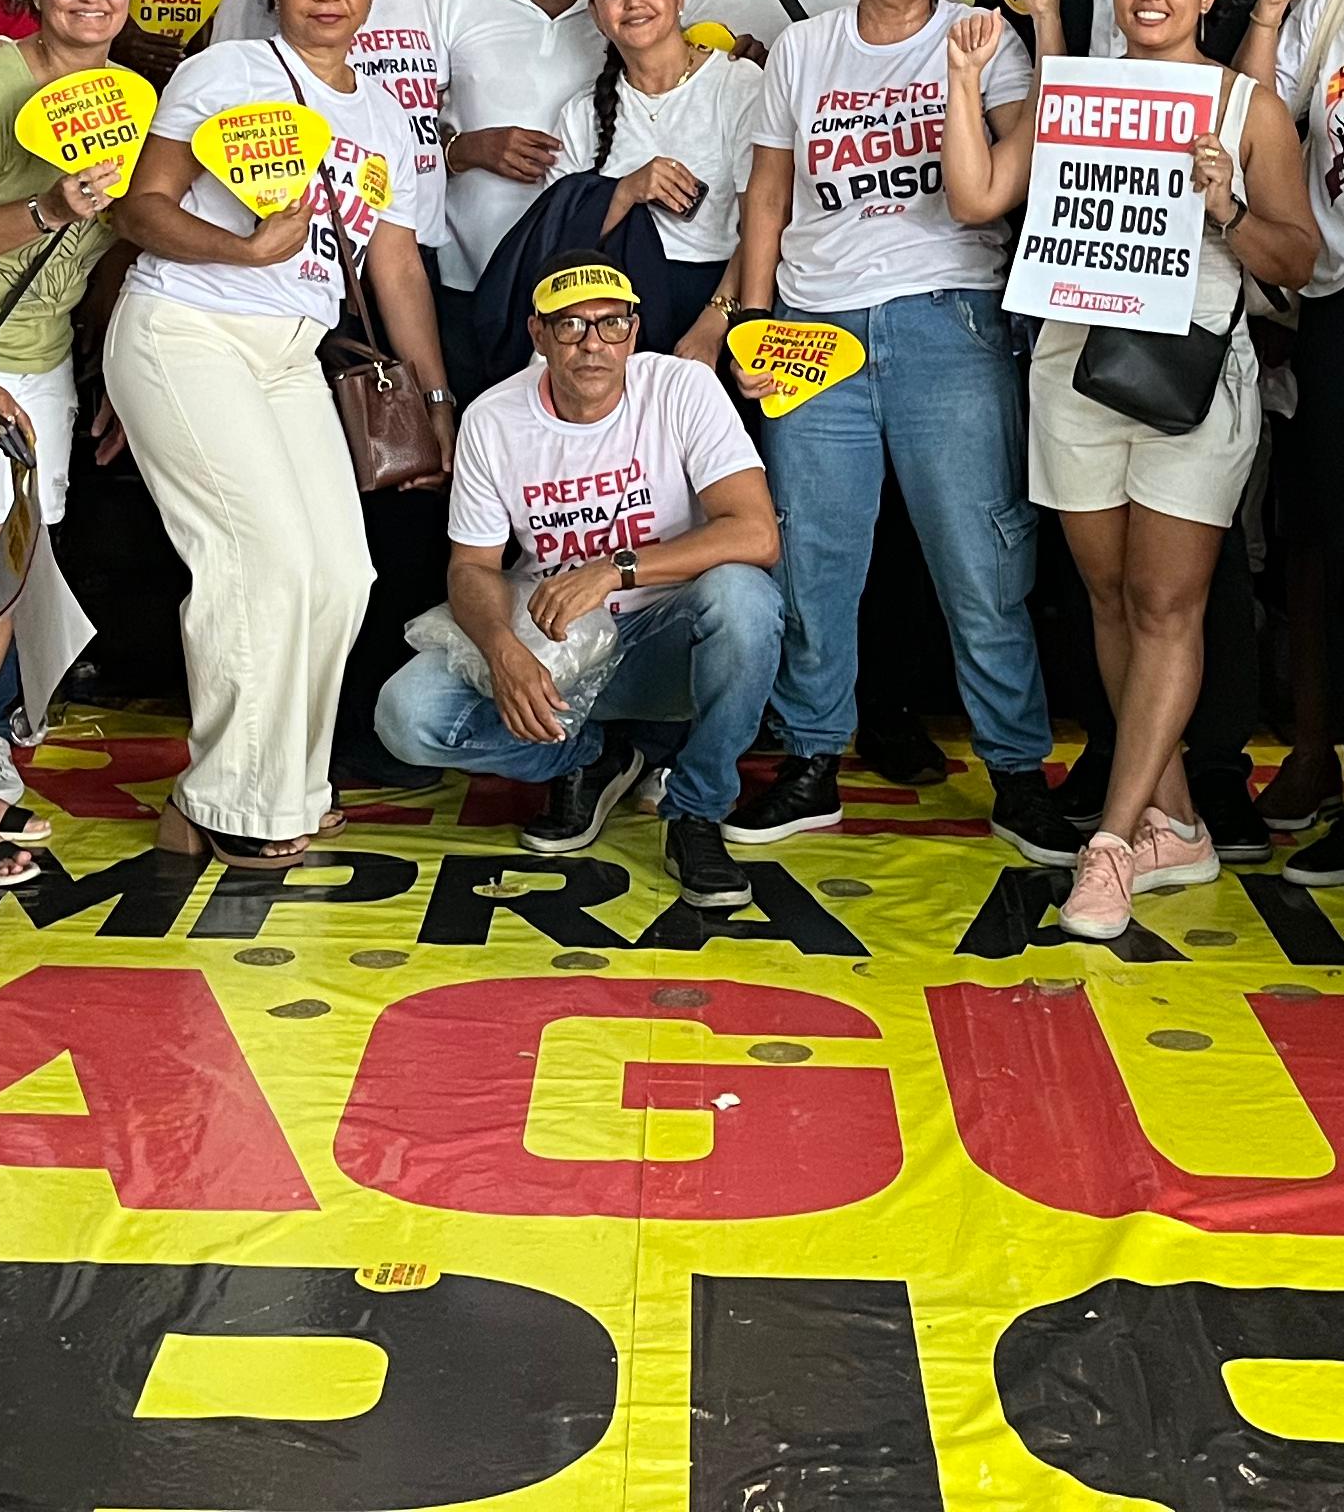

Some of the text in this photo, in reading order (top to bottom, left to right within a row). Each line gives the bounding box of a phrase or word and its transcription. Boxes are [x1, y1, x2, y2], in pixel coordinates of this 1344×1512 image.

[46, 100, 91, 122] CUMPRA
[92, 98, 102, 111] A
[816, 81, 944, 114] PREFEITO,
[51, 102, 132, 142] PAGUE
[810, 113, 889, 135] CUMPRA
[893, 111, 906, 125] A
[1042, 95, 1198, 143] PREFEITO,
[61, 122, 139, 162] O PISO!
[224, 136, 303, 164] PAGUE
[808, 119, 943, 176] PAGUE
[230, 158, 306, 184] O PISO!
[815, 165, 944, 211] O PISO
[1060, 161, 1183, 197] CUMPRA O
[1053, 196, 1167, 236] PISO DOS
[1023, 237, 1190, 278] PROFESSORES
[1081, 293, 1123, 313] PETISTA
[751, 358, 827, 386] O PISO!
[755, 343, 833, 367] PAGUE
[528, 506, 609, 530] CUMPRA
[534, 512, 661, 563] PAGUE
